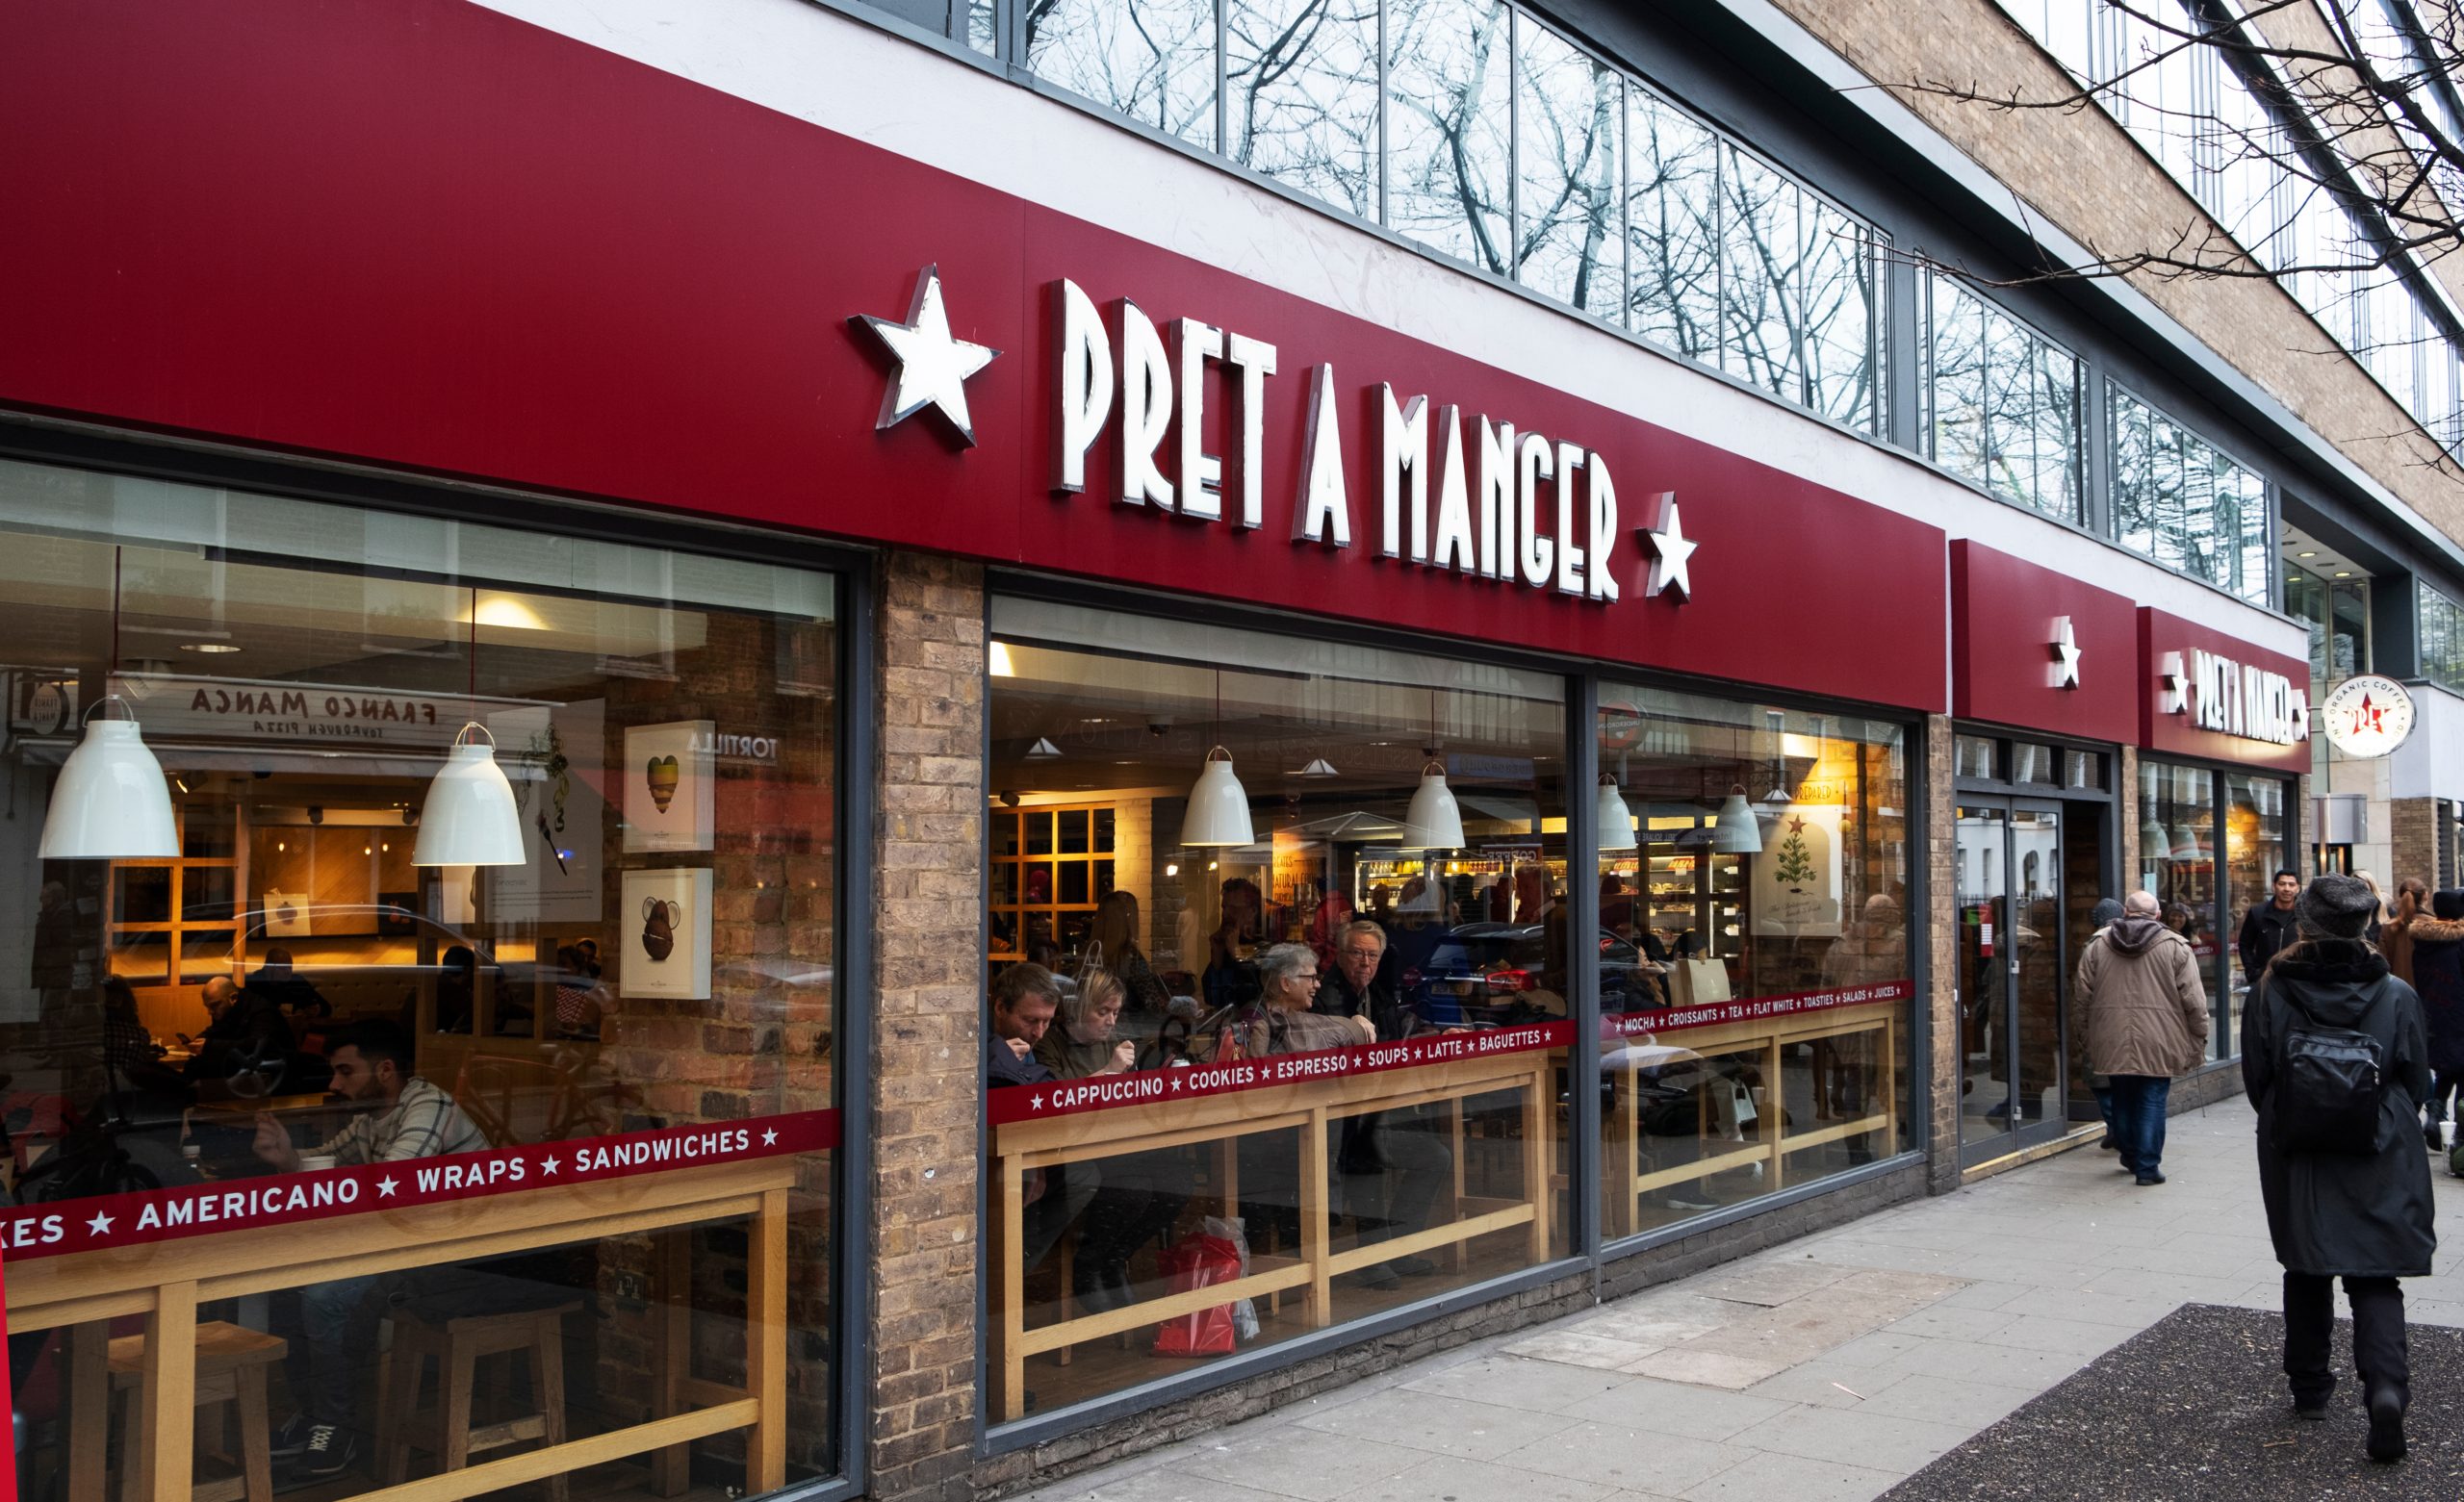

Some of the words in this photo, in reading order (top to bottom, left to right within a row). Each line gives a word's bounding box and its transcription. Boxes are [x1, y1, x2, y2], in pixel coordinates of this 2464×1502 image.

[1050, 278, 1277, 531] PRET
[1292, 361, 1350, 548] A
[1373, 380, 1620, 605] MANGER
[2329, 680, 2369, 715] ORGANIC
[2373, 680, 2406, 710] COFFEE
[2347, 702, 2389, 731] PRET
[1794, 785, 1832, 801] PREPARED
[1625, 1016, 1656, 1031] MOCHA
[1668, 1008, 1718, 1027] CROISSANTS
[1729, 1006, 1743, 1019] TEA
[1754, 1002, 1771, 1015] FLAT
[1773, 999, 1794, 1013] WHITE
[1804, 994, 1835, 1008] TOASTIES
[1842, 989, 1867, 1003] SALADS
[1875, 986, 1896, 999] JUICES
[1052, 1077, 1164, 1108] CAPPUCCINO
[1189, 1066, 1254, 1090] COOKIES
[1277, 1055, 1348, 1079] ESPRESSO
[1368, 1047, 1409, 1067] SOUPS
[1427, 1039, 1463, 1058] LATTE
[1479, 1030, 1540, 1052] BAGUETTES
[136, 1178, 360, 1232] AMERICANO
[417, 1157, 526, 1193] WRAPS
[576, 1129, 750, 1173] SANDWICHES
